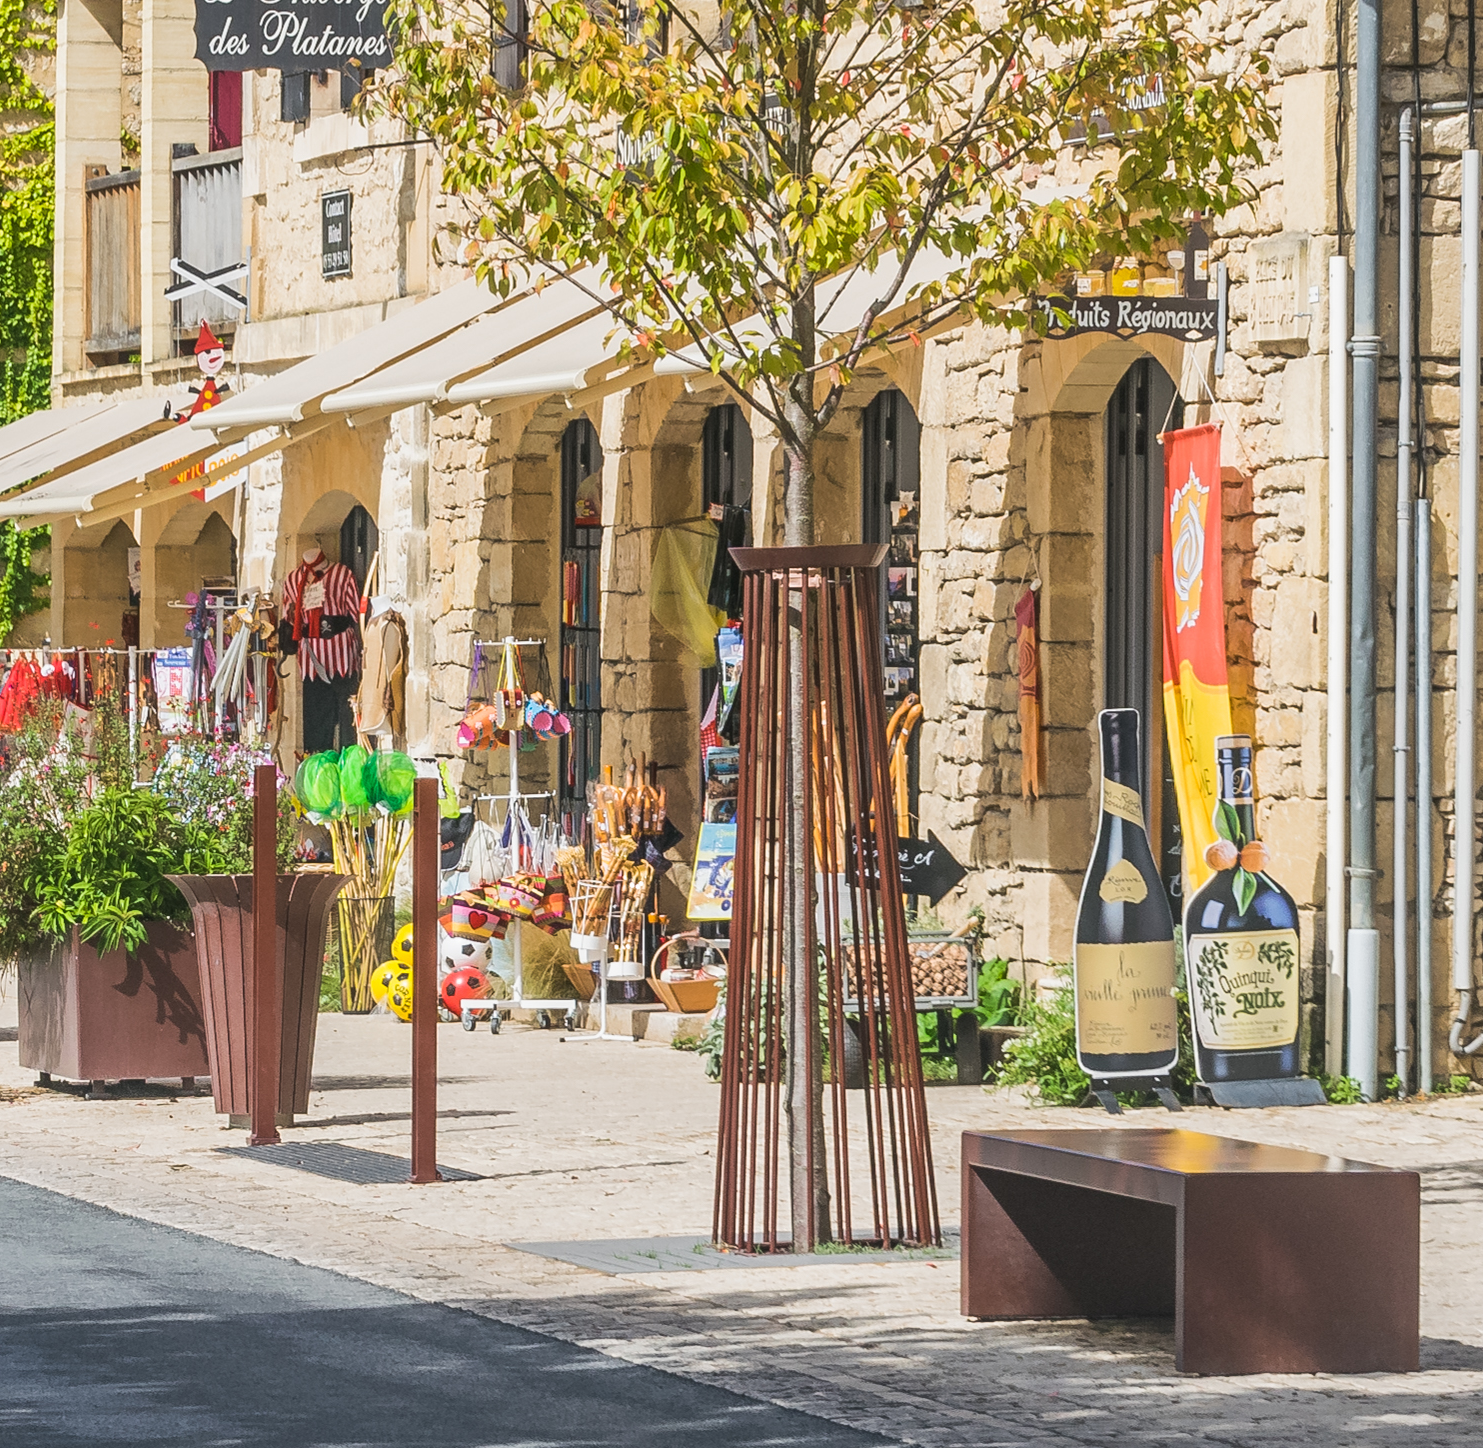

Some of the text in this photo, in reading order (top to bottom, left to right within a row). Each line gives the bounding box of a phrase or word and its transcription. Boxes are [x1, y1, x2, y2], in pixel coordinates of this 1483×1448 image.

[209, 10, 387, 56] des Platanes
[1117, 301, 1215, 333] Régionaux
[1219, 969, 1275, 998] Quinqui
